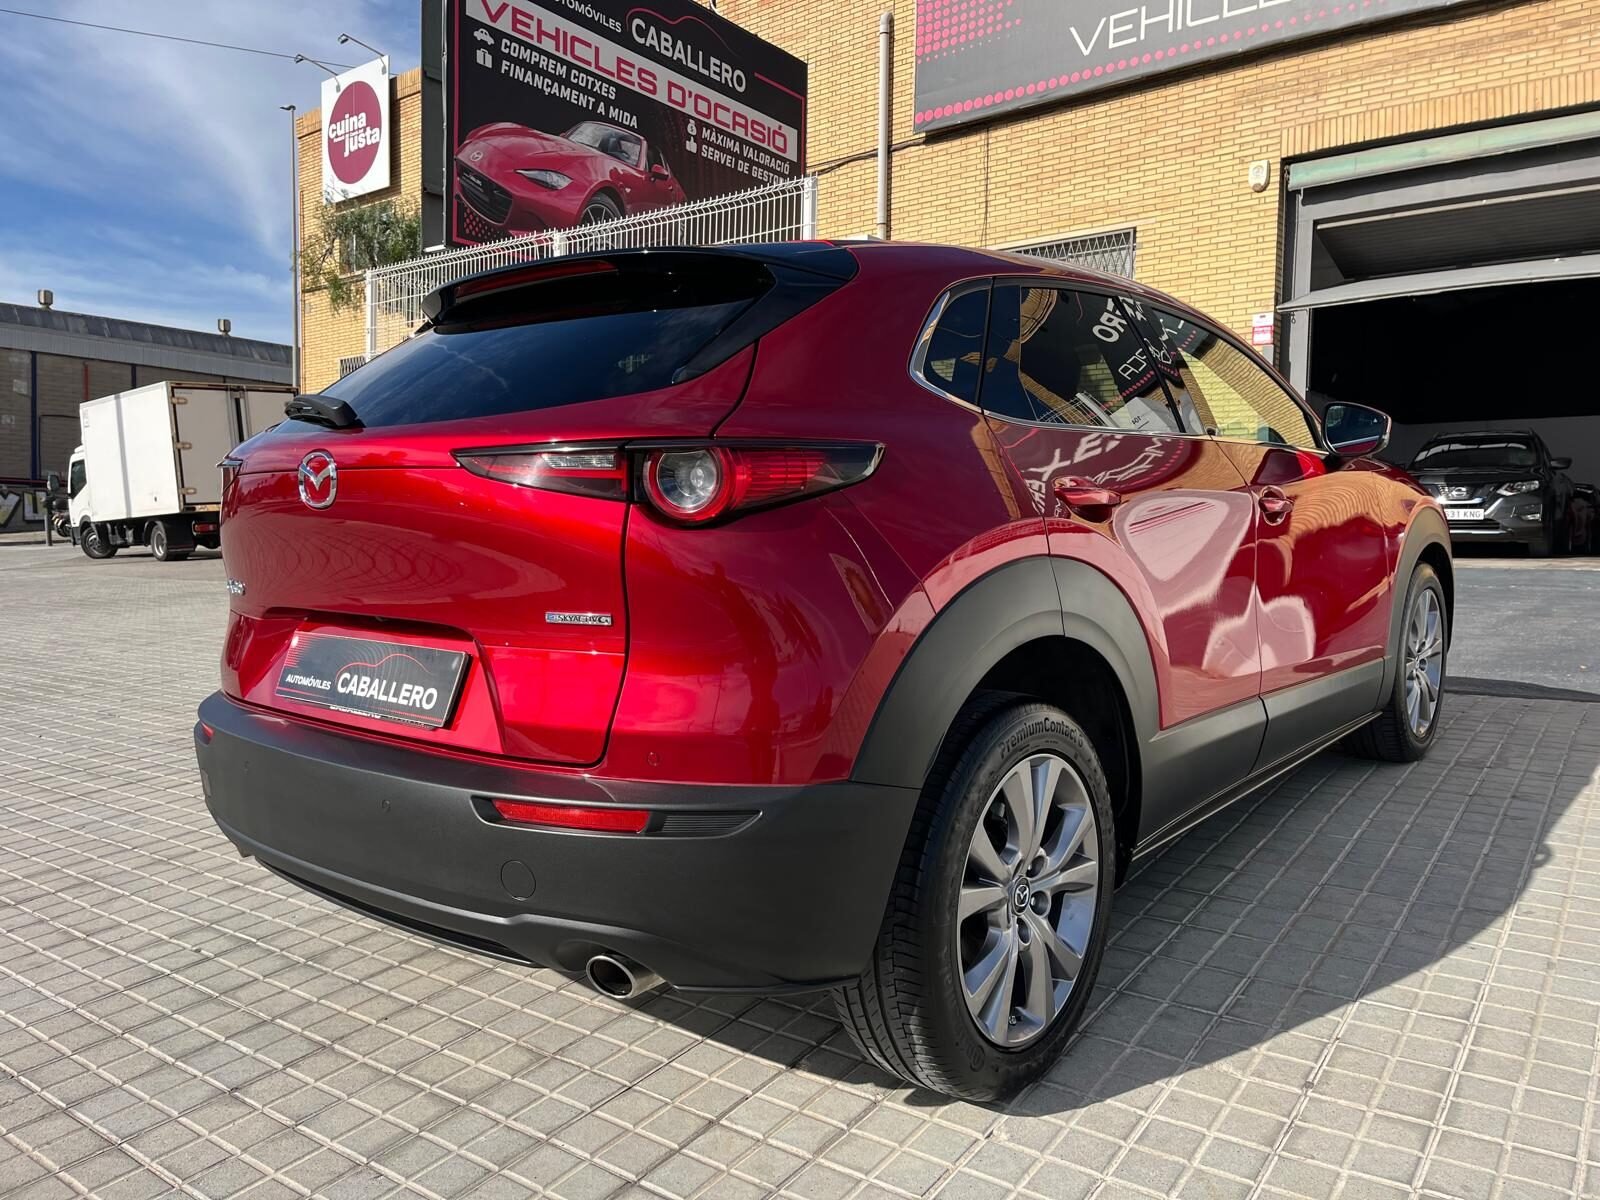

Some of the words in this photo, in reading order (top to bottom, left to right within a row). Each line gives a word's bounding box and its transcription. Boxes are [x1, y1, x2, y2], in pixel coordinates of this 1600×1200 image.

[501, 38, 567, 79] COMPREM
[570, 69, 617, 100] COTXES
[631, 17, 747, 93] CABALLERO
[480, 0, 658, 96] VEHICLES
[666, 80, 788, 154] D'OCASIÓ
[501, 61, 596, 111] FINANÇAMENT
[597, 102, 606, 116] A
[608, 106, 638, 129] MIDA
[328, 112, 367, 139] cuina
[343, 126, 380, 158] justa
[701, 127, 741, 154] MÀXIMA
[742, 145, 791, 175] VALORACIÓ
[701, 144, 736, 169] SERVEI
[737, 159, 750, 174] DE
[1463, 510, 1481, 518] KNG
[285, 673, 332, 691] AUTOMÓVILES
[336, 671, 438, 711] CABALLERO
[999, 716, 1077, 759] PremiumContact
